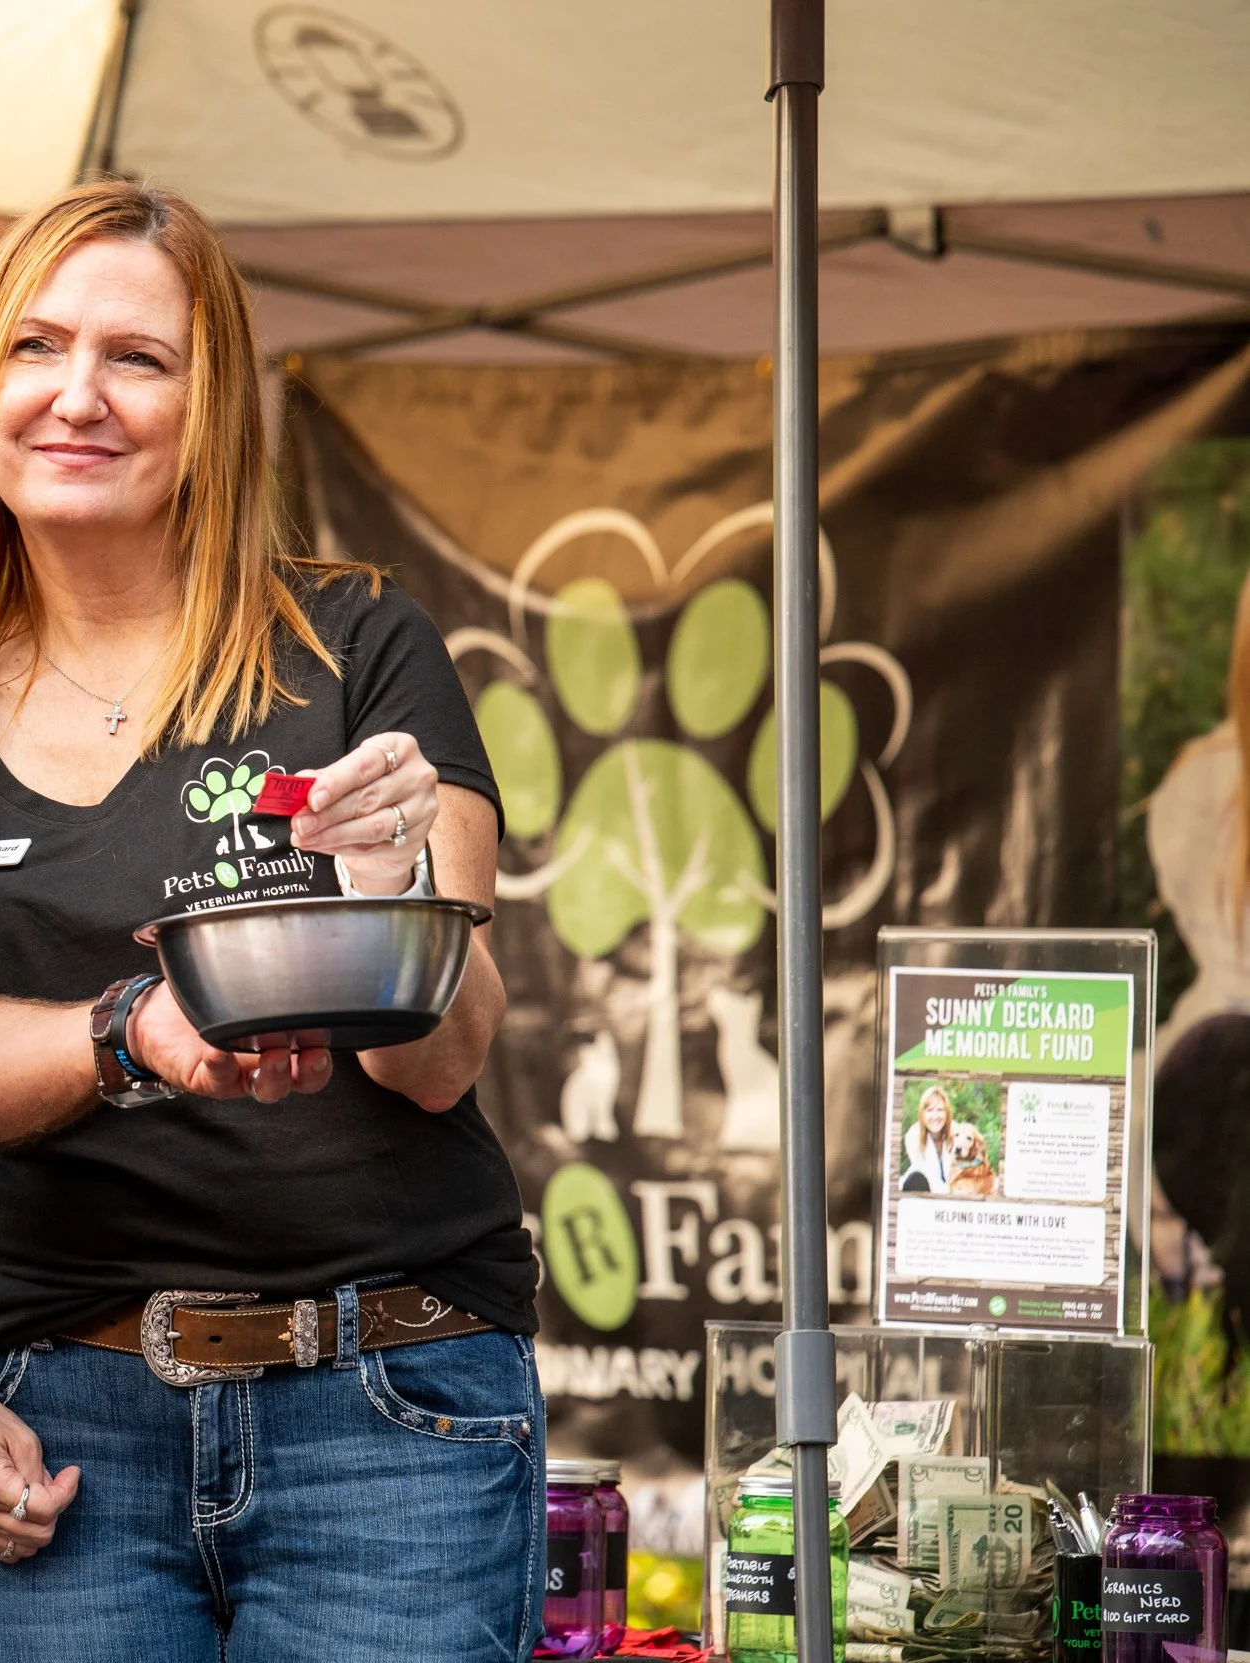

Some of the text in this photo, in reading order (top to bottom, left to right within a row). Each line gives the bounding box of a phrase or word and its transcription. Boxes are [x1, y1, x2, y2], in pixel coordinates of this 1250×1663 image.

[163, 849, 315, 899] Pets R Family
[186, 883, 310, 912] VETERINARY HOSPITAL
[974, 983, 997, 997] PETS
[1007, 984, 1048, 998] FAMILY'S
[925, 997, 1095, 1031] SUNNY DECKARD
[924, 1028, 1094, 1062] MEMORIAL FUND
[934, 1210, 1067, 1229] HELPING OTHERS WITH LOVE
[557, 1204, 622, 1286] R
[630, 1180, 873, 1305] Fam
[1004, 1504, 1023, 1533] 20
[1103, 1577, 1163, 1594] CERAMICS
[1071, 1601, 1101, 1620] Pet
[1140, 1596, 1181, 1609] NERD
[1123, 1612, 1151, 1623] GIFT
[1155, 1613, 1190, 1623] CARD
